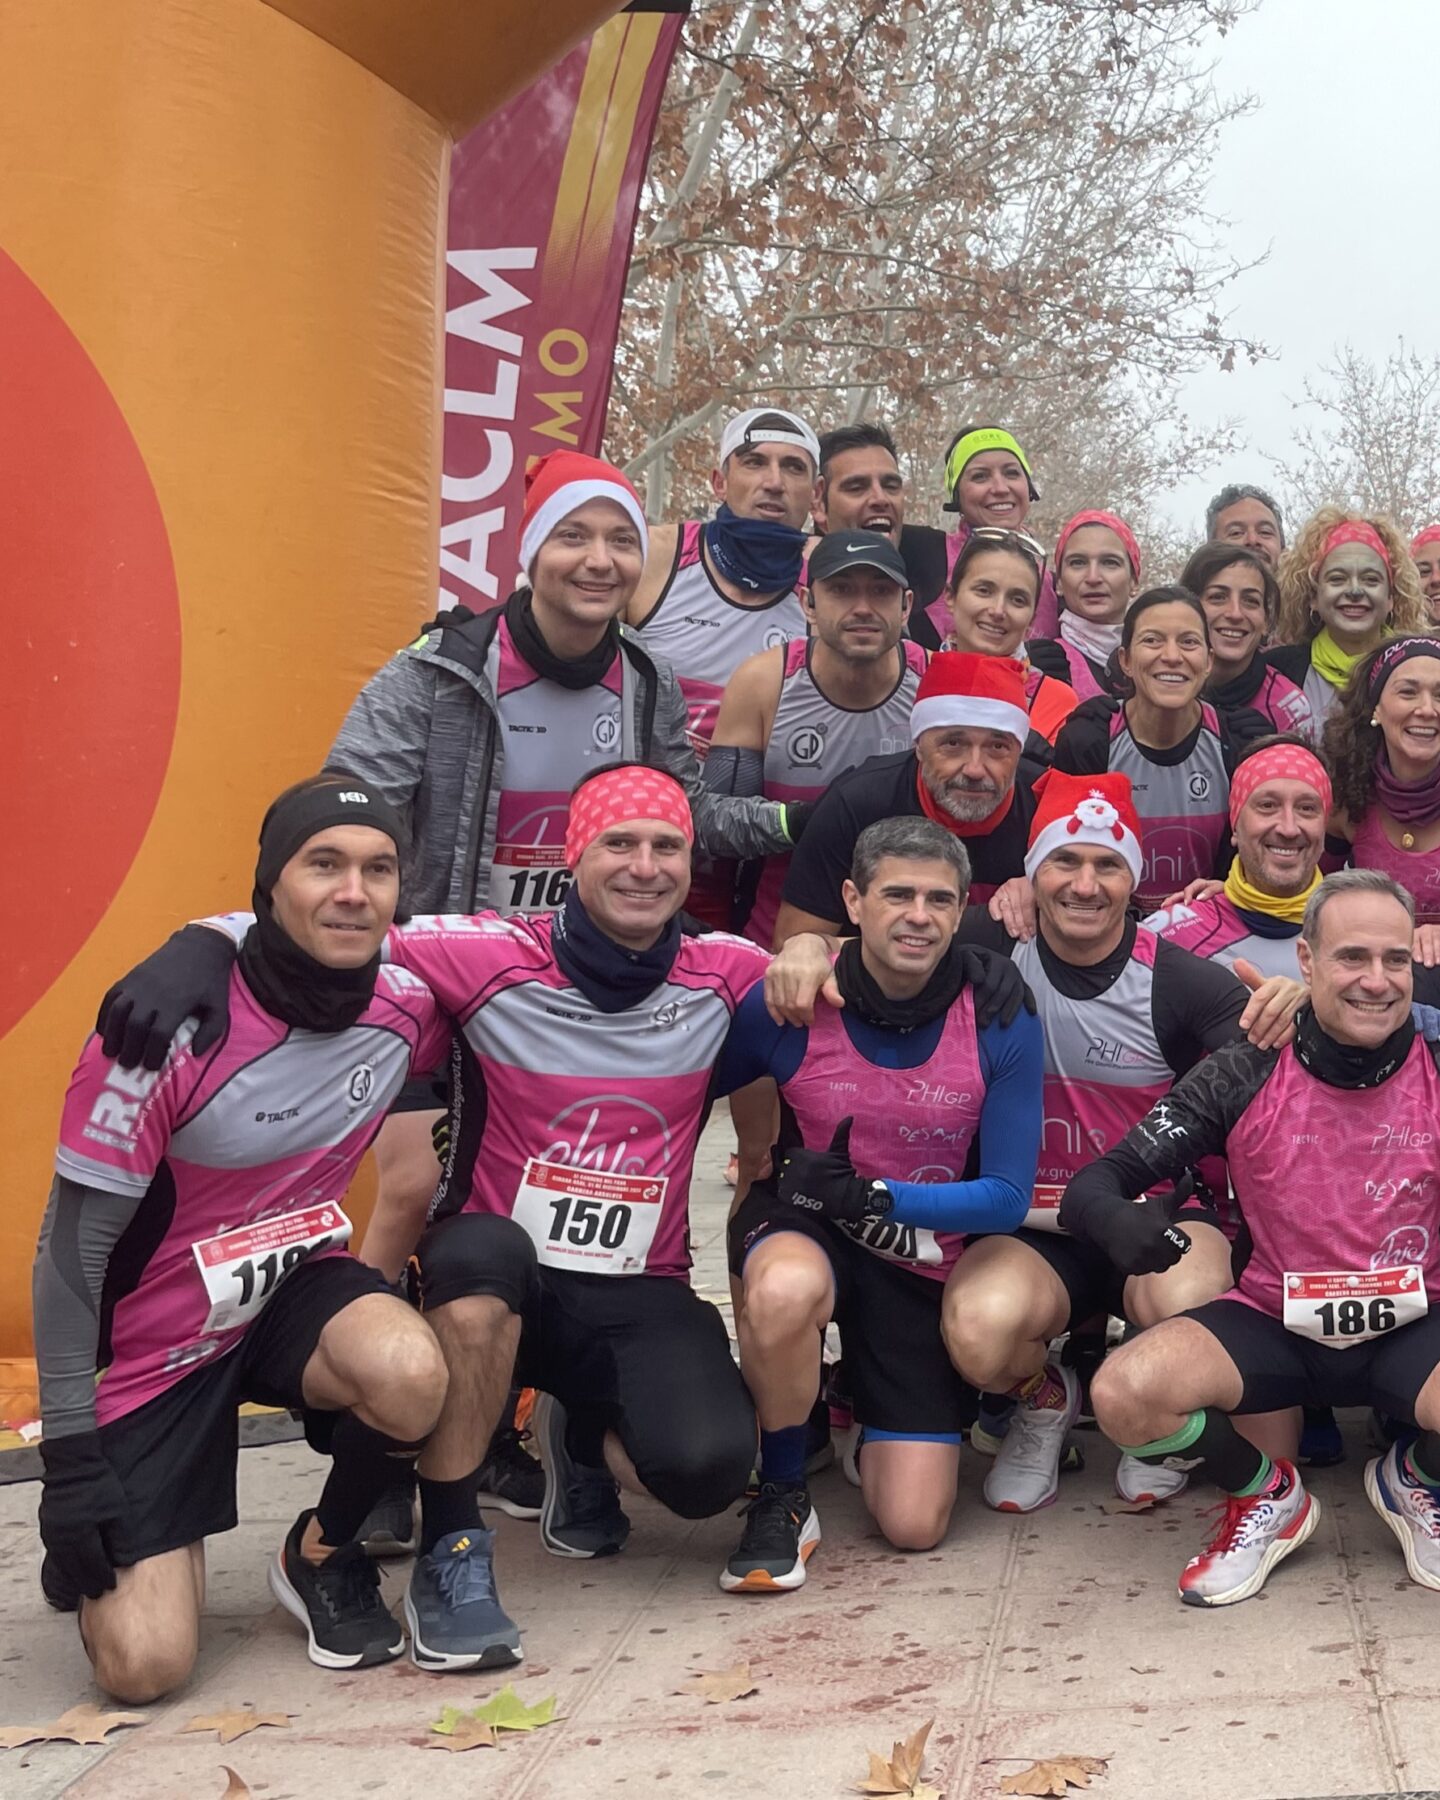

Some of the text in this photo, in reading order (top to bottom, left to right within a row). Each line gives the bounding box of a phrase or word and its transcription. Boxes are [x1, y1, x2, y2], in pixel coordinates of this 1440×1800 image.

[548, 1197, 632, 1249] 150
[1163, 1228, 1185, 1249] FILA
[1314, 1298, 1396, 1336] 186
